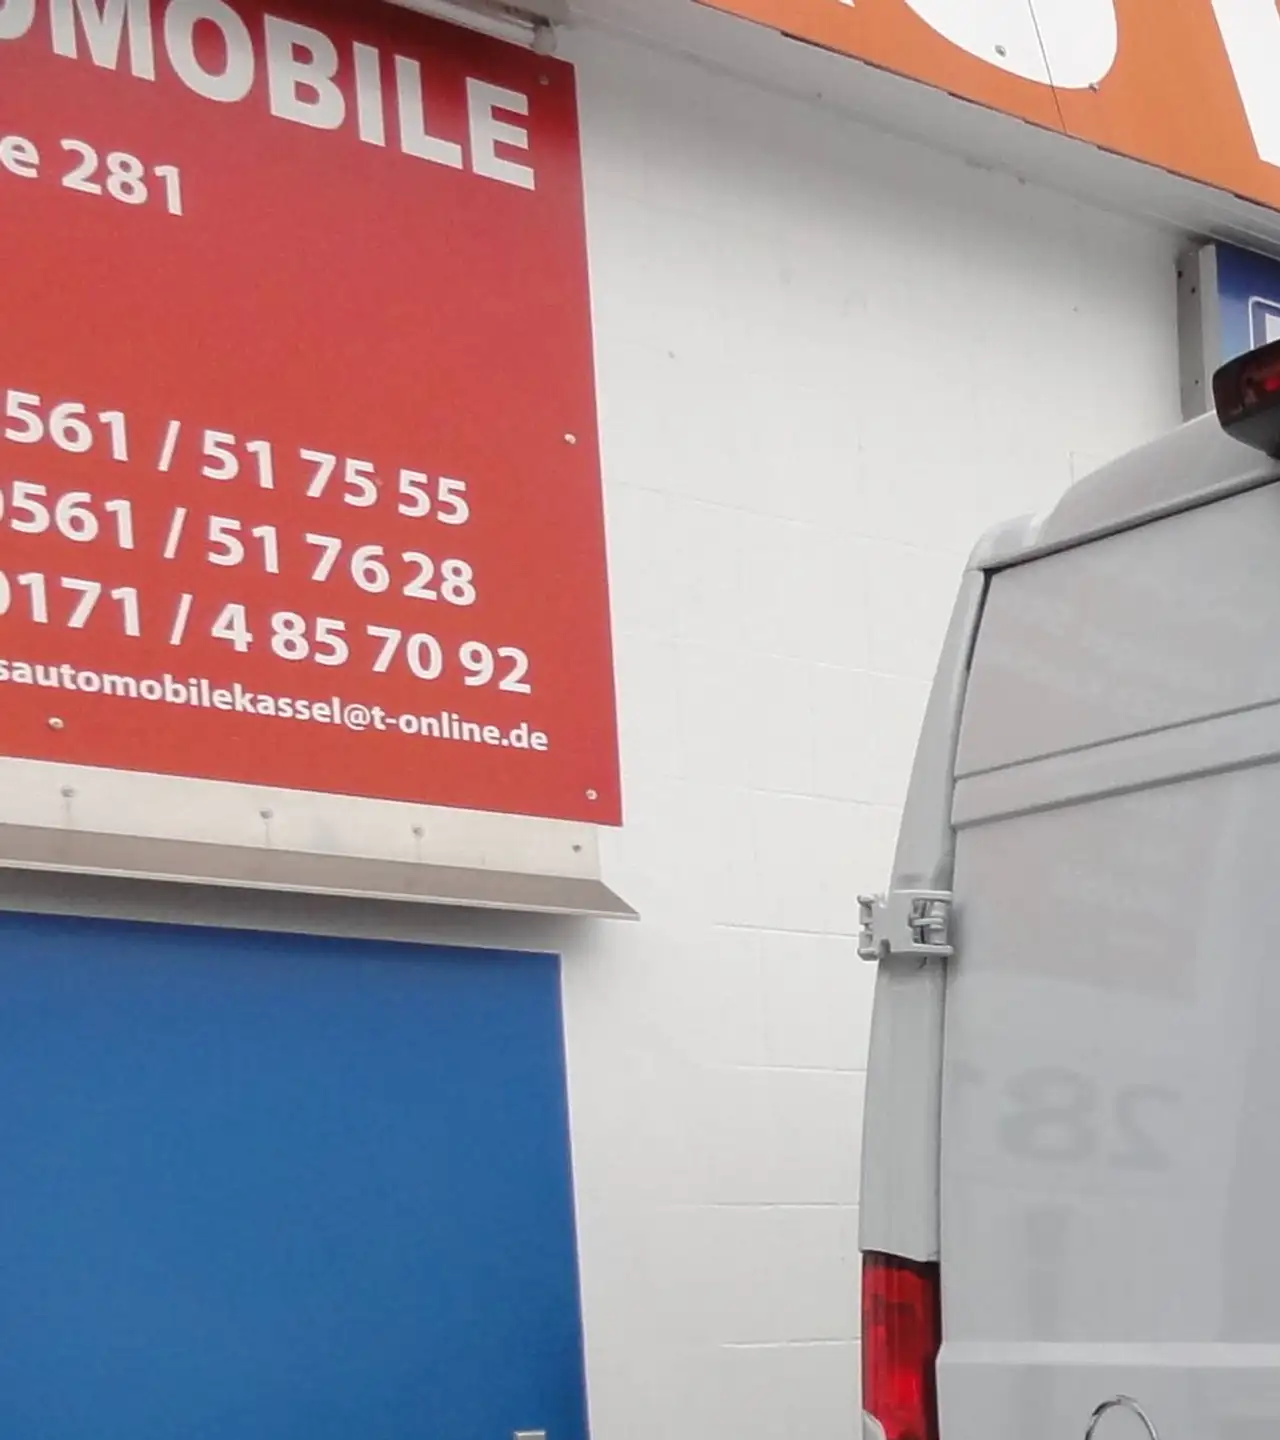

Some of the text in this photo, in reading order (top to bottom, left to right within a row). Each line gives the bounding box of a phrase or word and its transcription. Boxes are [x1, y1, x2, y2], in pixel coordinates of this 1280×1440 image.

[60, 138, 184, 216] 281
[5, 389, 471, 526] 561 / 51 75 55
[0, 481, 477, 607] 561 / 51 76 28
[169, 593, 193, 646] /
[210, 602, 254, 653] 4
[270, 611, 349, 666] 85
[366, 624, 443, 680] 70
[458, 640, 532, 694] 92
